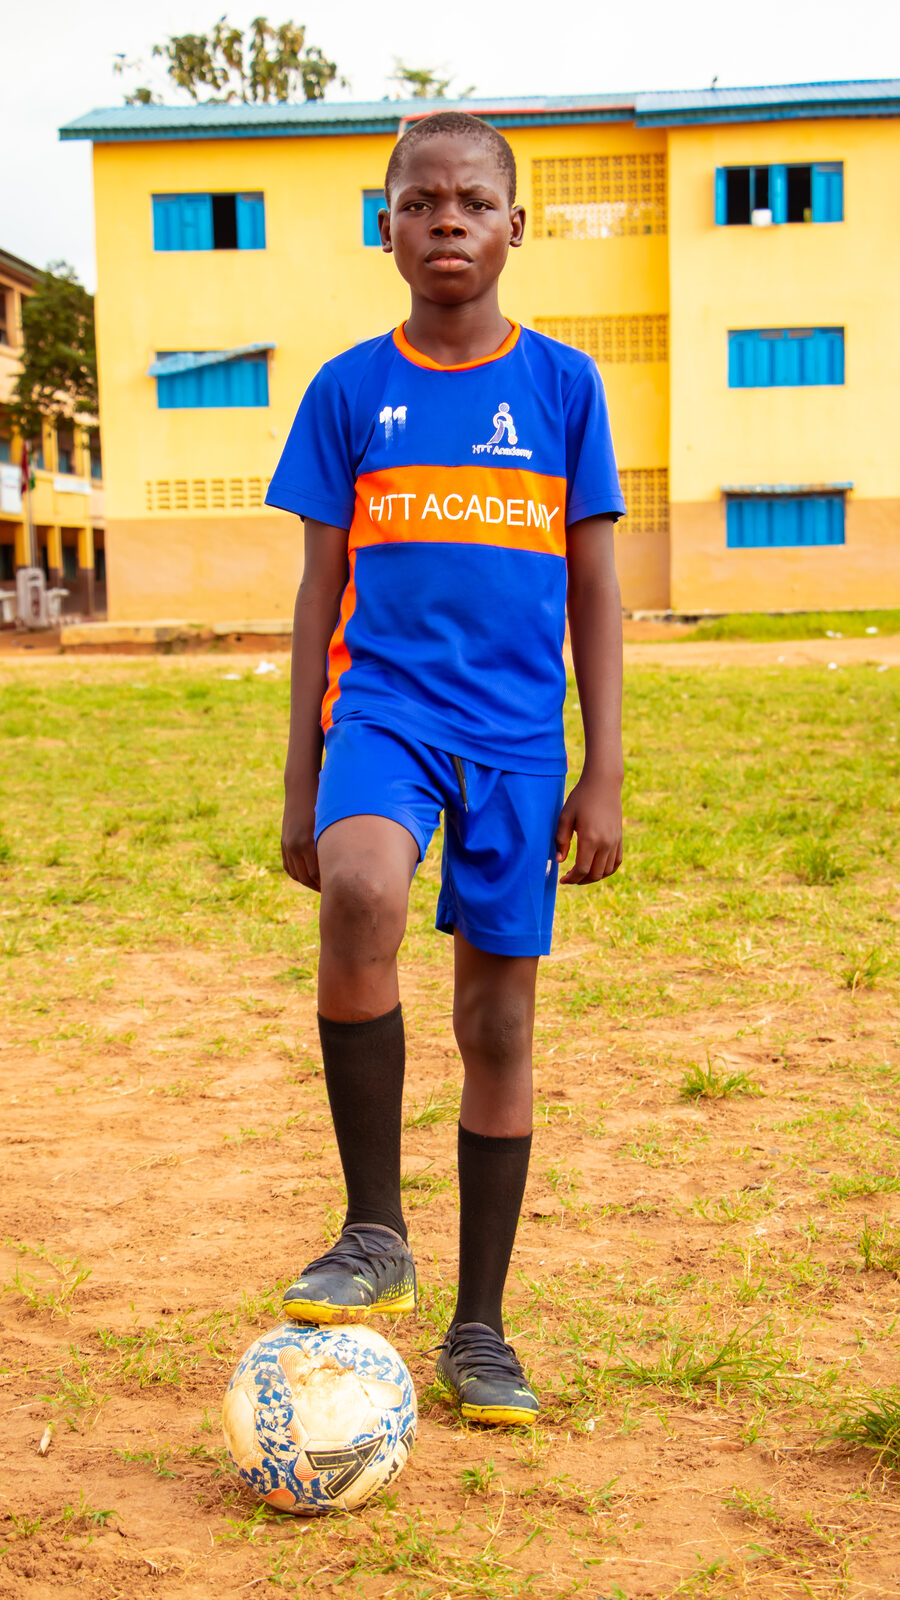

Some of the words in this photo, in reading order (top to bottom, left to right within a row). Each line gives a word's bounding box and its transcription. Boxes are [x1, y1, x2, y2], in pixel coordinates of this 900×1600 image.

[471, 444, 493, 455] HTT
[492, 445, 533, 460] Academy
[368, 493, 417, 521] HTT
[421, 493, 560, 532] ACADEMY
